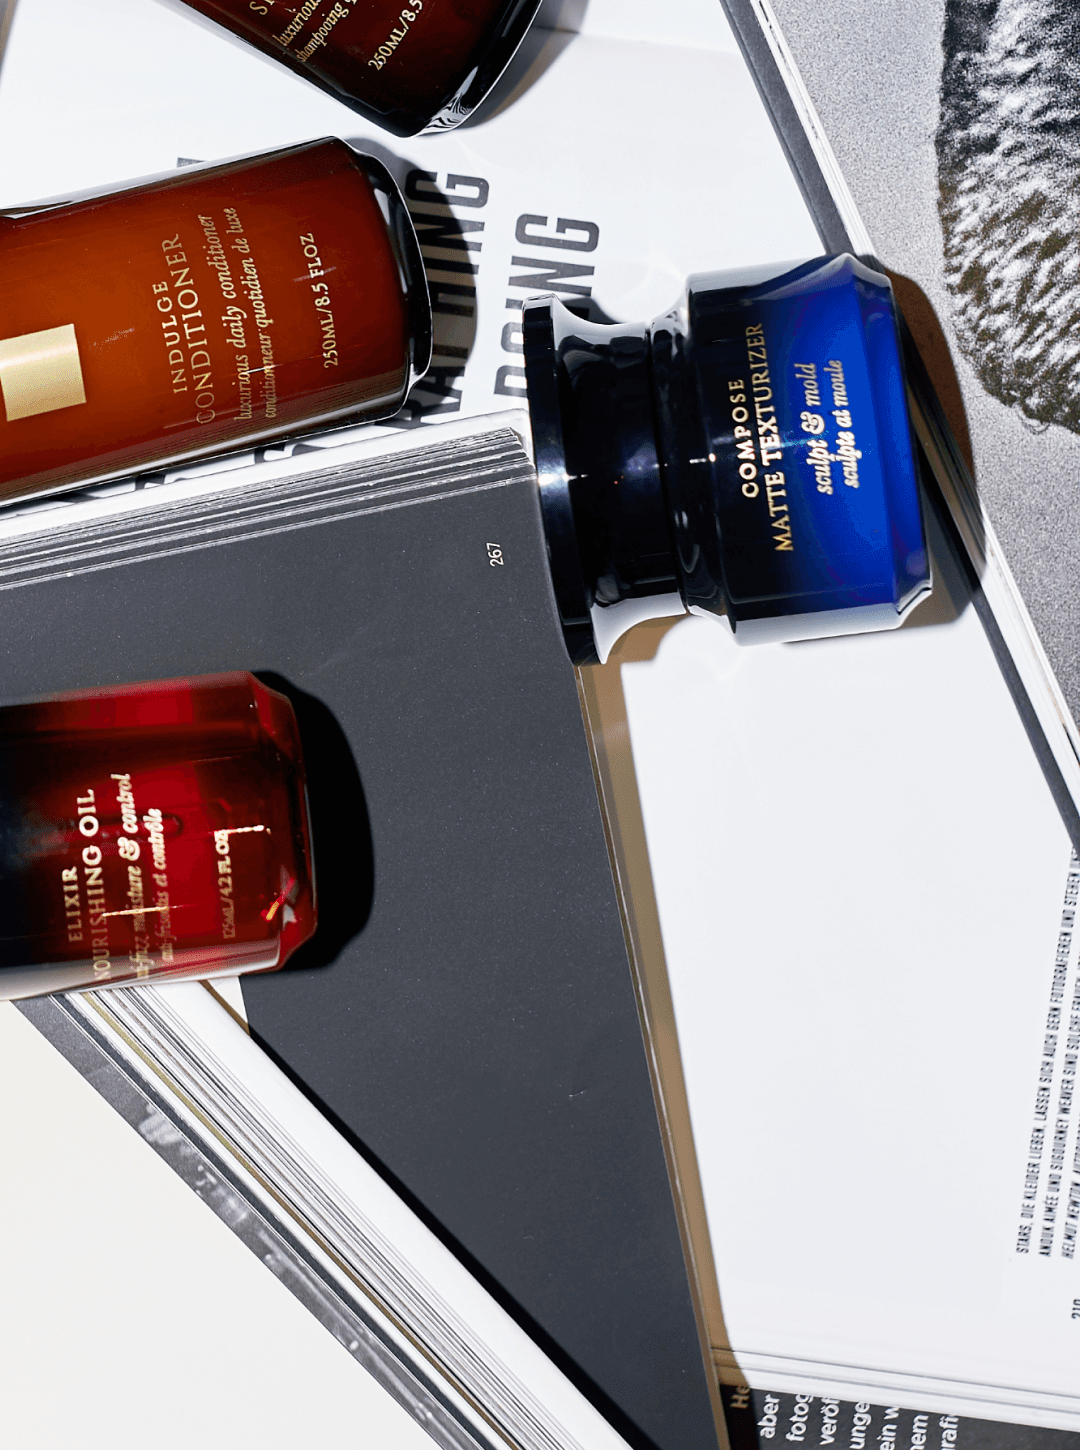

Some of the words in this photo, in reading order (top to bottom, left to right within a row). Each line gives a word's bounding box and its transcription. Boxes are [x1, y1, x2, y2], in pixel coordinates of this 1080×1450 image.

[295, 2, 349, 62] shampooing
[224, 208, 243, 233] luxe
[198, 215, 236, 298] conditioner
[231, 238, 250, 253] de
[300, 233, 324, 278] FLOZ
[242, 258, 273, 327] quotidien
[153, 282, 187, 393] INDULGE
[163, 234, 214, 423] CONDITIONER
[223, 306, 247, 348] daily
[311, 283, 337, 368] 250ML/8.5
[231, 355, 253, 420] luxurious
[259, 333, 276, 418] conditionneur
[746, 324, 782, 466] TEXTURIZER
[794, 363, 821, 406] mold
[824, 361, 848, 406] moule
[729, 380, 759, 497] COMPOSE
[800, 412, 824, 434] &
[832, 410, 852, 427] at
[803, 438, 834, 495] sculpt
[836, 432, 862, 488] sculpte
[765, 472, 793, 550] MATTE
[486, 542, 504, 567] 267
[77, 789, 98, 836] OIL
[111, 774, 138, 833] control
[118, 837, 140, 860] &
[143, 809, 166, 869] contrôle
[153, 874, 167, 887] et
[62, 867, 82, 941] ELIXIR
[82, 845, 112, 981] NOURISHING
[1063, 910, 1075, 927] UND
[1050, 933, 1071, 1002] FOTOGRAFIEREN
[1047, 1008, 1060, 1030] GERN
[1044, 1035, 1056, 1057] AUCH
[1063, 1054, 1077, 1075] SIND
[1040, 1062, 1053, 1082] SICH
[1035, 1088, 1049, 1120] LASSEN
[1060, 1079, 1073, 1114] WEAVER
[1030, 1124, 1046, 1159] LIEBEN,
[1050, 1120, 1068, 1170] SIGOURNEY
[1025, 1163, 1039, 1199] KLEIDER
[1049, 1174, 1061, 1192] UND
[1021, 1204, 1034, 1218] DIE
[1044, 1196, 1058, 1222] AIMÉE
[1016, 1221, 1033, 1253] STARS,
[1040, 1228, 1053, 1255] ANOUK
[1061, 1222, 1076, 1256] HELMUT
[757, 1394, 780, 1439] aber
